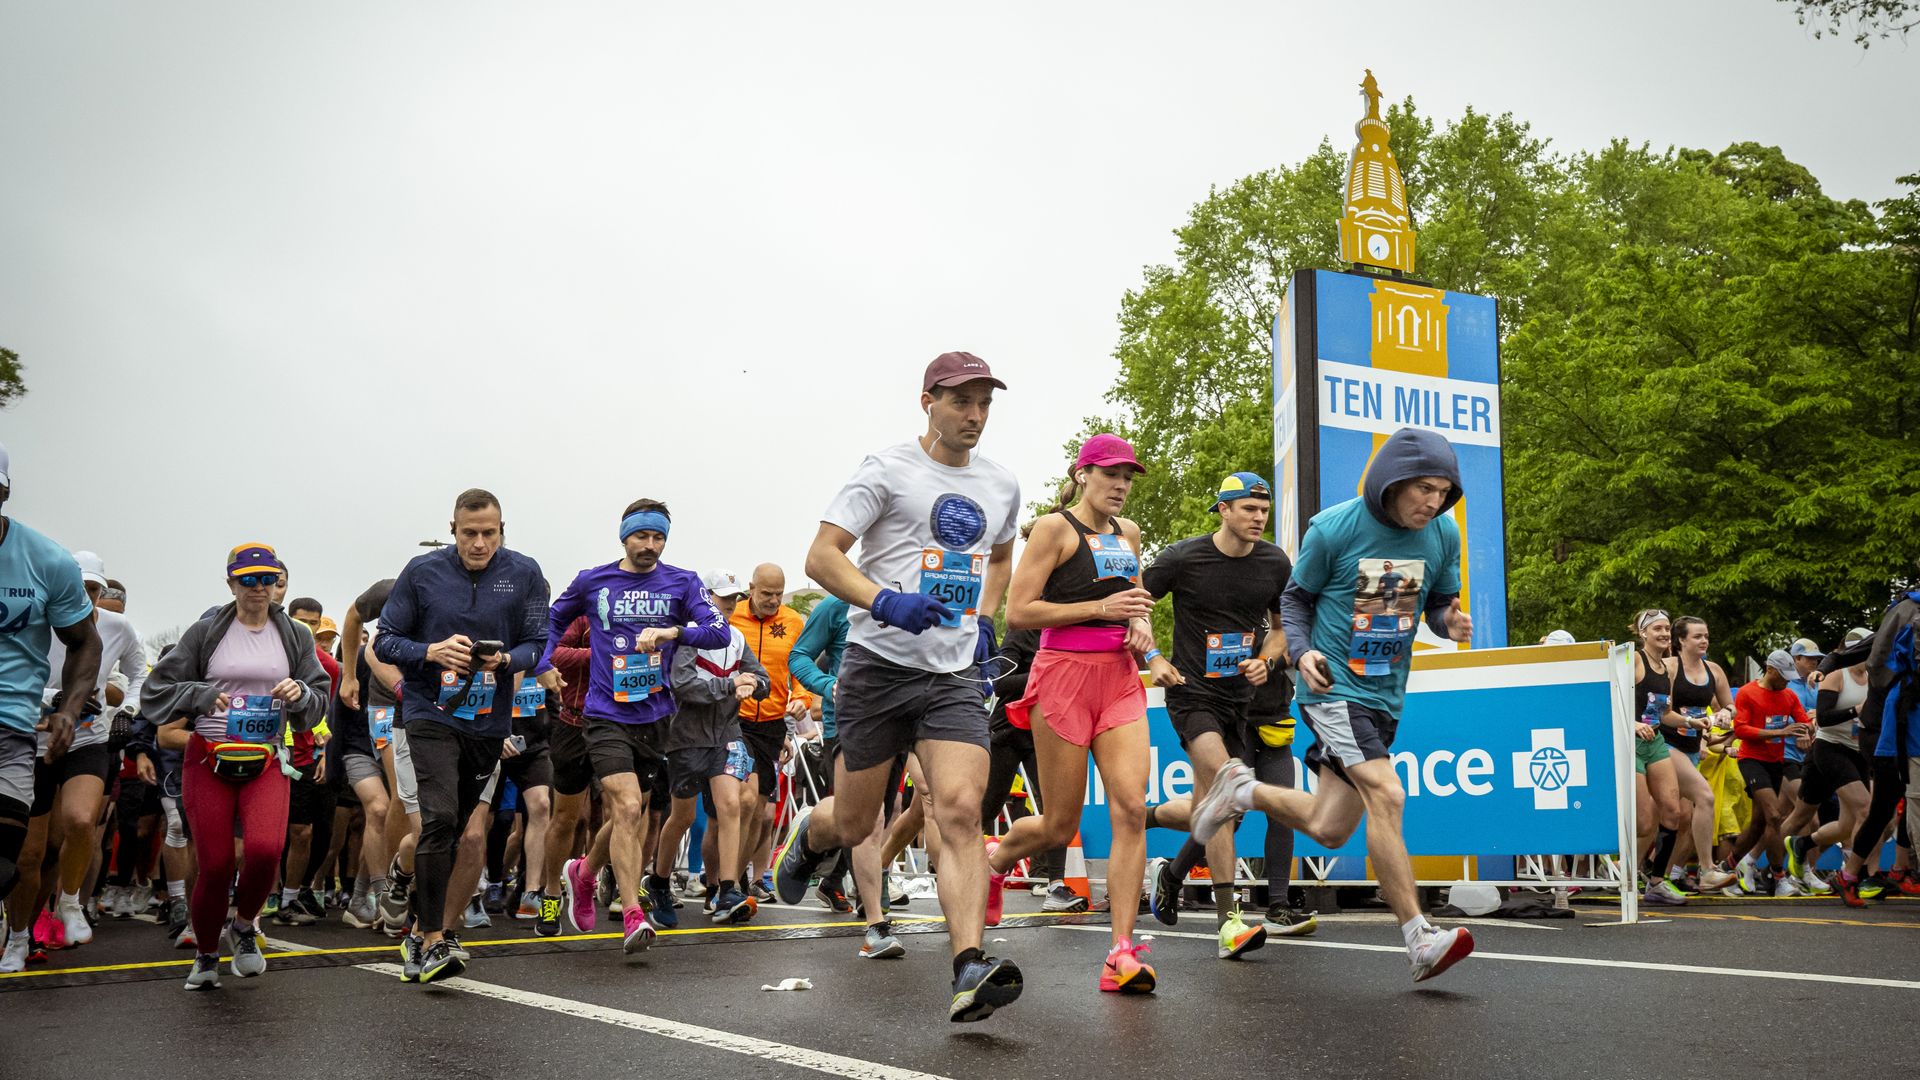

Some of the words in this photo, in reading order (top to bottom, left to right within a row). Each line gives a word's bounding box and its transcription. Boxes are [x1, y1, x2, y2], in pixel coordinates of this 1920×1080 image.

[1324, 375, 1382, 420] TEN
[1394, 386, 1492, 433] MILER
[1104, 558, 1135, 572] 4695
[622, 590, 649, 602] xpn
[929, 583, 973, 604] 4501
[1358, 640, 1402, 656] 4760
[620, 674, 656, 688] 4308
[515, 693, 542, 705] 6173
[236, 719, 274, 734] 1665
